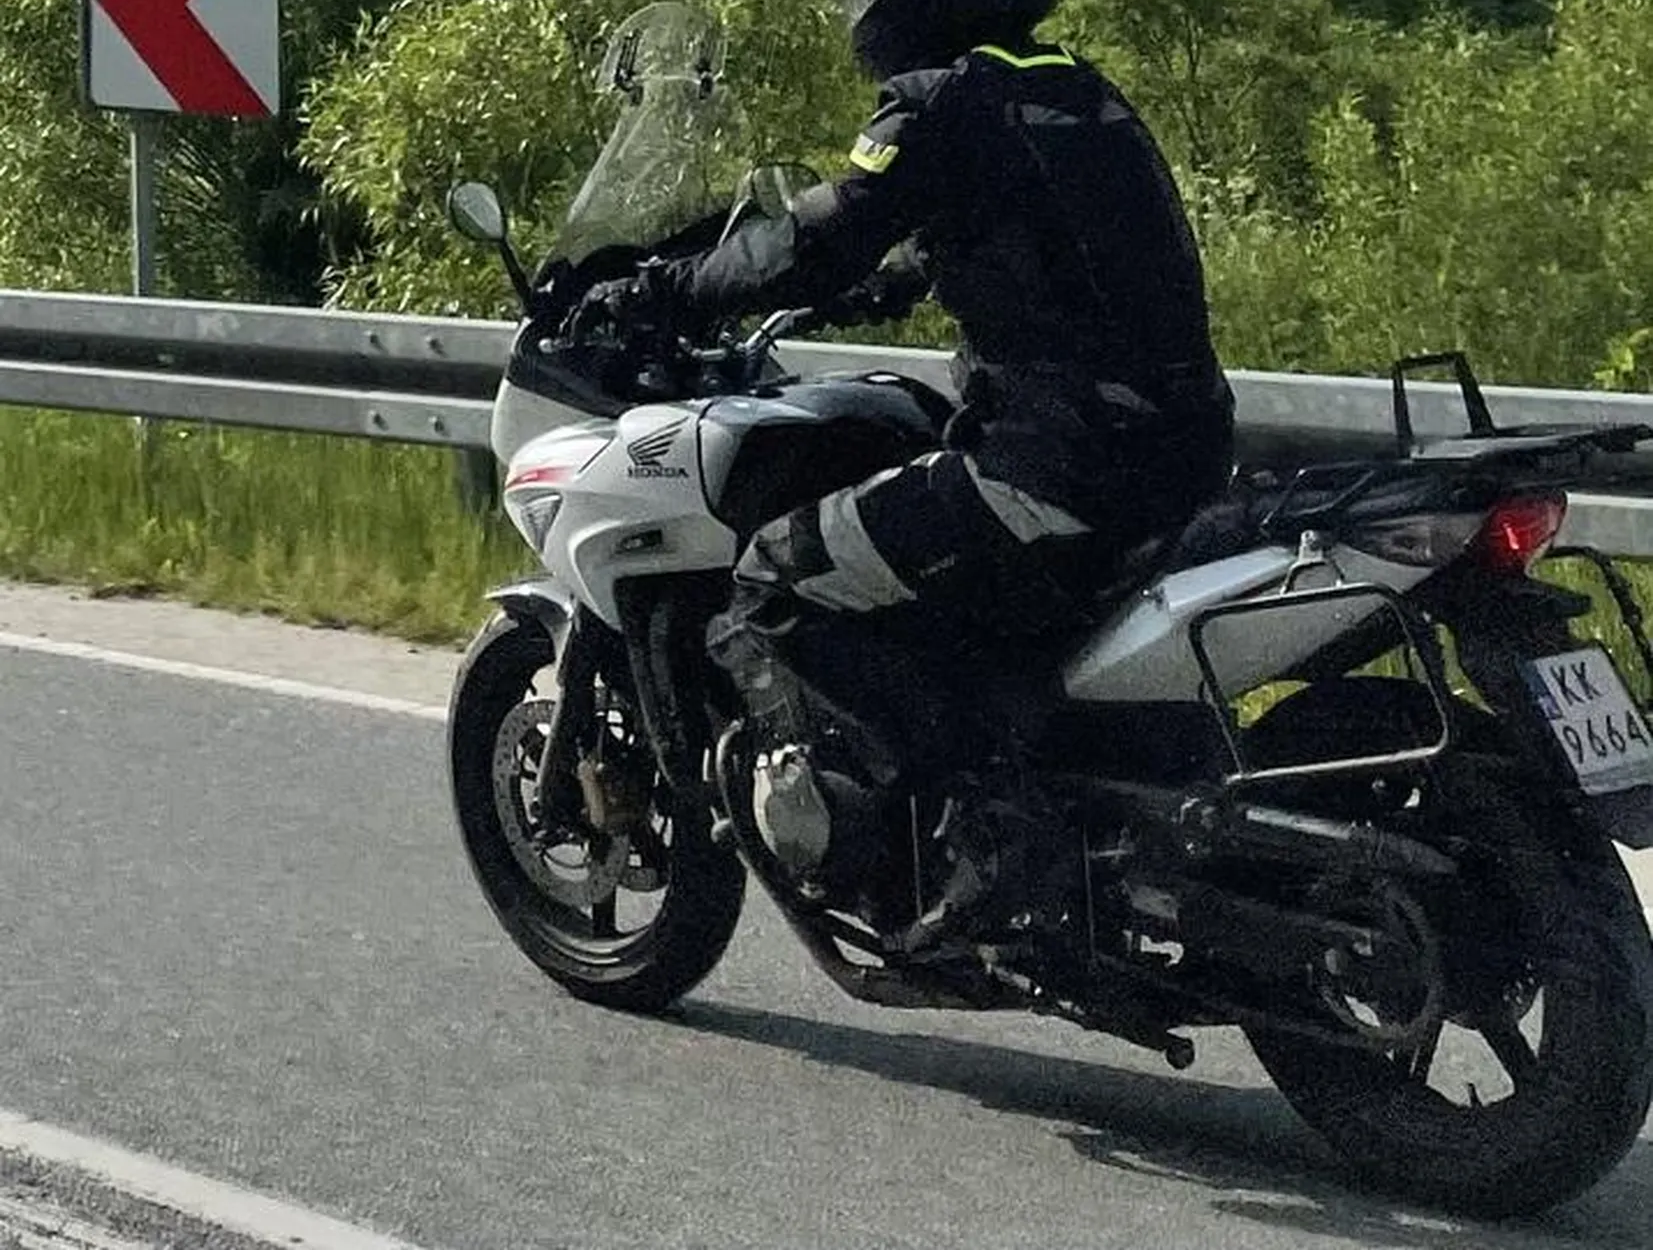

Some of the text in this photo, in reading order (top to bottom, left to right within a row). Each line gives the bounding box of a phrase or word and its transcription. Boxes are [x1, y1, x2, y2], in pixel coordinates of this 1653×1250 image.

[627, 466, 690, 479] HONDA
[1550, 661, 1603, 706] KK
[1563, 710, 1649, 764] 9664
